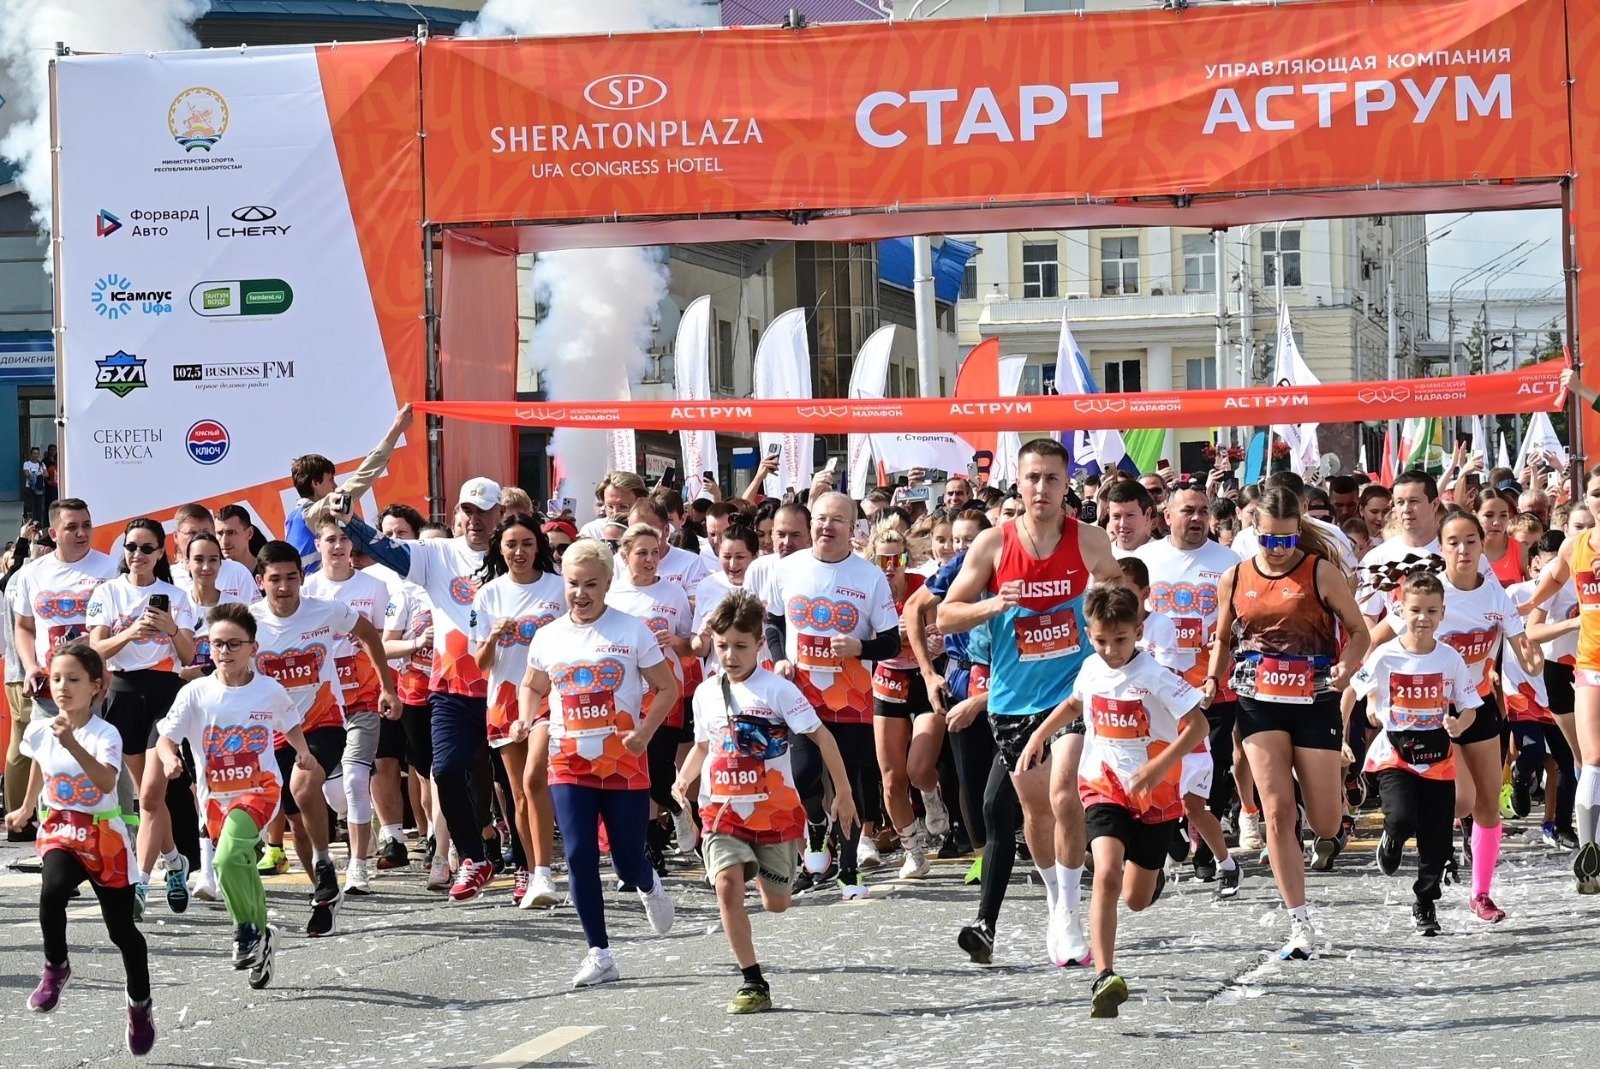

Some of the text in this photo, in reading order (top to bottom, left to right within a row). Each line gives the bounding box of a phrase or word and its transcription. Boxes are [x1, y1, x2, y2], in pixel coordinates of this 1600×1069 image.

[1205, 47, 1512, 80] УПРАВЛЯЮЩАЯ КОМПАНИЯ
[608, 79, 645, 106] SP
[1202, 73, 1513, 135] АСТРУМ
[855, 81, 1119, 149] СТАРТ
[490, 117, 764, 154] SHERATONPLAZA
[154, 164, 242, 173] РЕСПУБЛИКИ БАШКОРТОСТАН
[532, 157, 723, 178] UFA CONGRESS HOTEL
[130, 208, 199, 223] Форвард
[131, 226, 168, 237] Авто
[216, 225, 291, 238] CHERY
[110, 290, 172, 304] Кампус
[97, 366, 145, 382] БХЛ
[174, 361, 295, 380] 107,5 BUSINESS FM
[1414, 380, 1466, 389] УФИМСКИЙ
[1224, 393, 1309, 409] АСТРУМ
[1414, 393, 1466, 402] МАРАФОН
[670, 406, 753, 419] АСТРУМ
[852, 409, 903, 418] МАРАФОН
[949, 402, 1032, 415] АСТРУМ
[1130, 404, 1181, 412] МАРАФОН
[569, 413, 621, 422] МАРАФОН
[93, 428, 162, 444] СЕКРЕТЫ
[195, 429, 220, 437] КРАСНЫЙ
[104, 445, 153, 460] ВКУСА
[195, 446, 221, 456] КЛЮЧ
[835, 588, 867, 600] АСТРУМ
[1024, 623, 1070, 644] 20055
[272, 665, 312, 681] 21193
[1262, 671, 1306, 687] 20973
[1396, 686, 1438, 699] 21313
[567, 705, 609, 721] 21586
[1097, 712, 1138, 728] 21564
[211, 765, 254, 783] 21959
[715, 770, 758, 785] 20180
